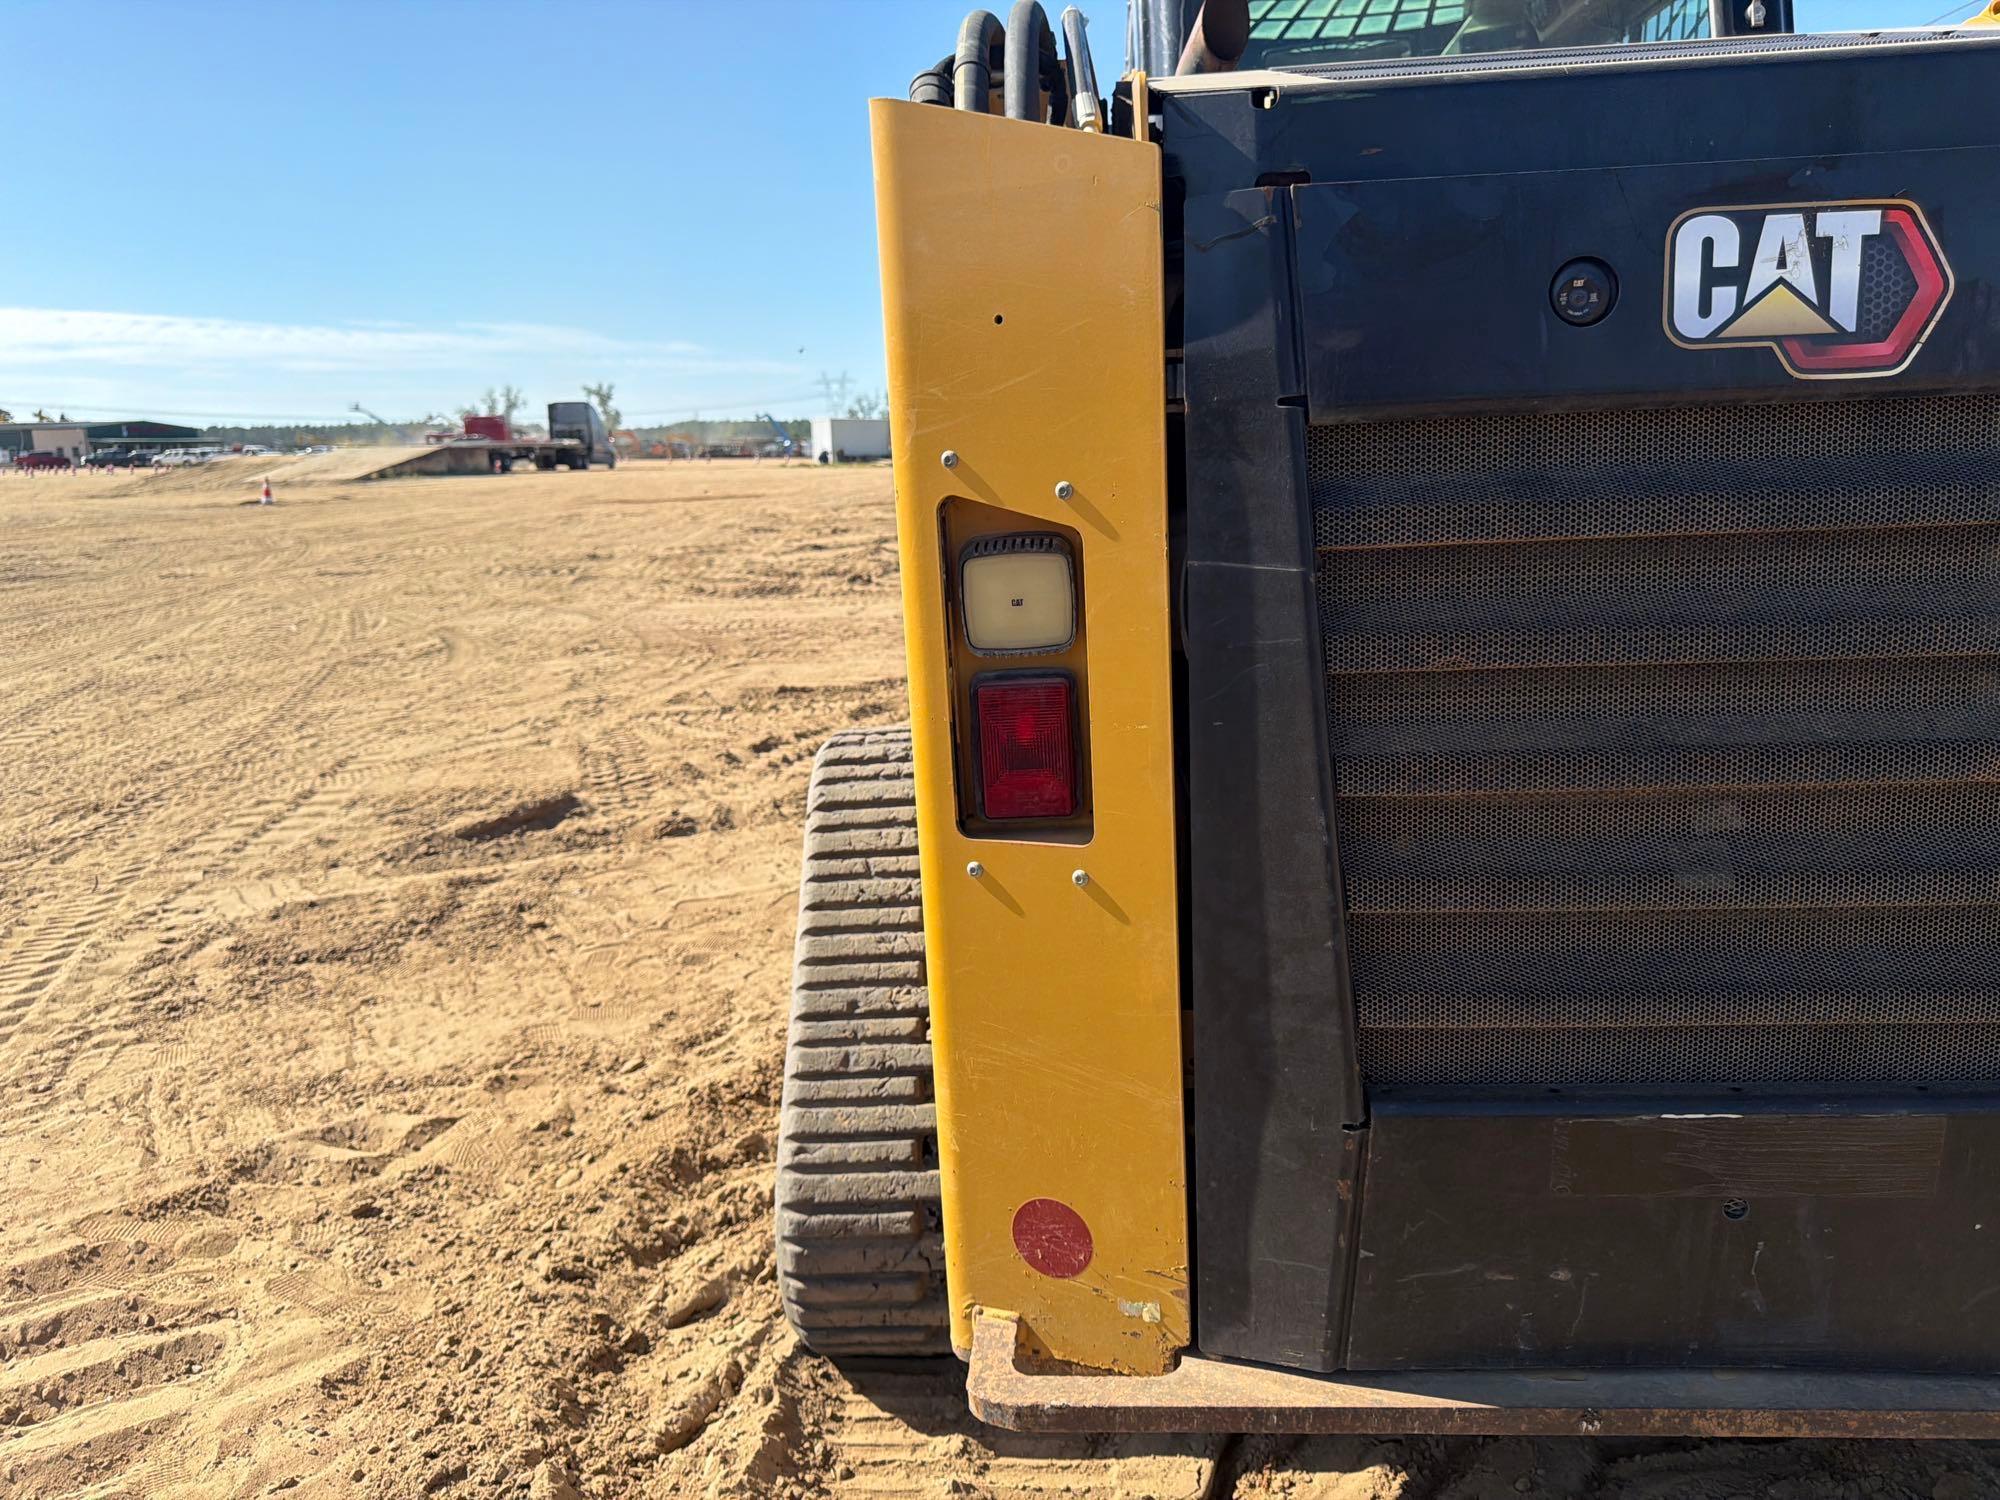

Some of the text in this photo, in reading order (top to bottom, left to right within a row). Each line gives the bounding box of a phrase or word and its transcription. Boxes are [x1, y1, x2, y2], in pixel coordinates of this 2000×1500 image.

[1673, 210, 1882, 339] CAT
[1573, 279, 1585, 287] CAT
[1011, 599, 1024, 607] CAT
